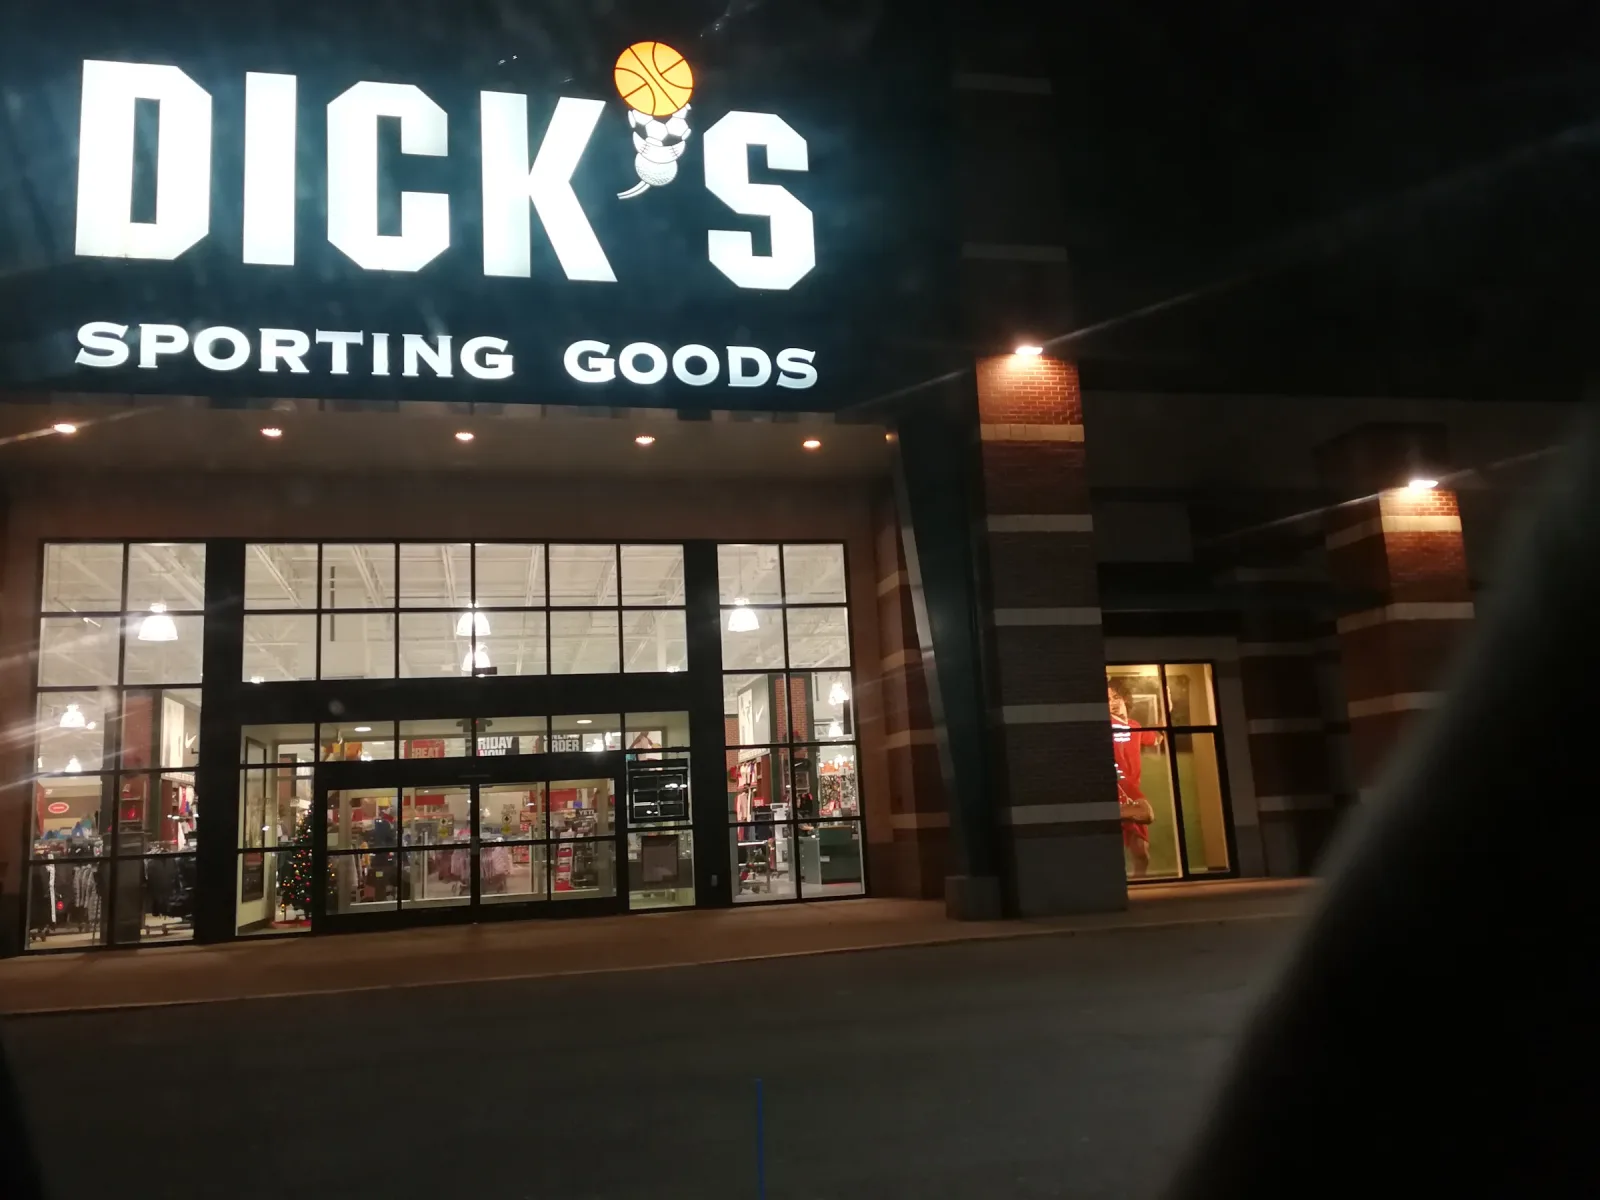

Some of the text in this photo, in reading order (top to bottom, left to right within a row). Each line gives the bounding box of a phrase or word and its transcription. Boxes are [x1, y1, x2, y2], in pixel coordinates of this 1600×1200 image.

[75, 42, 817, 290] DICK'S
[75, 322, 818, 389] SPORTING GOODS
[477, 736, 513, 749] RIDAY
